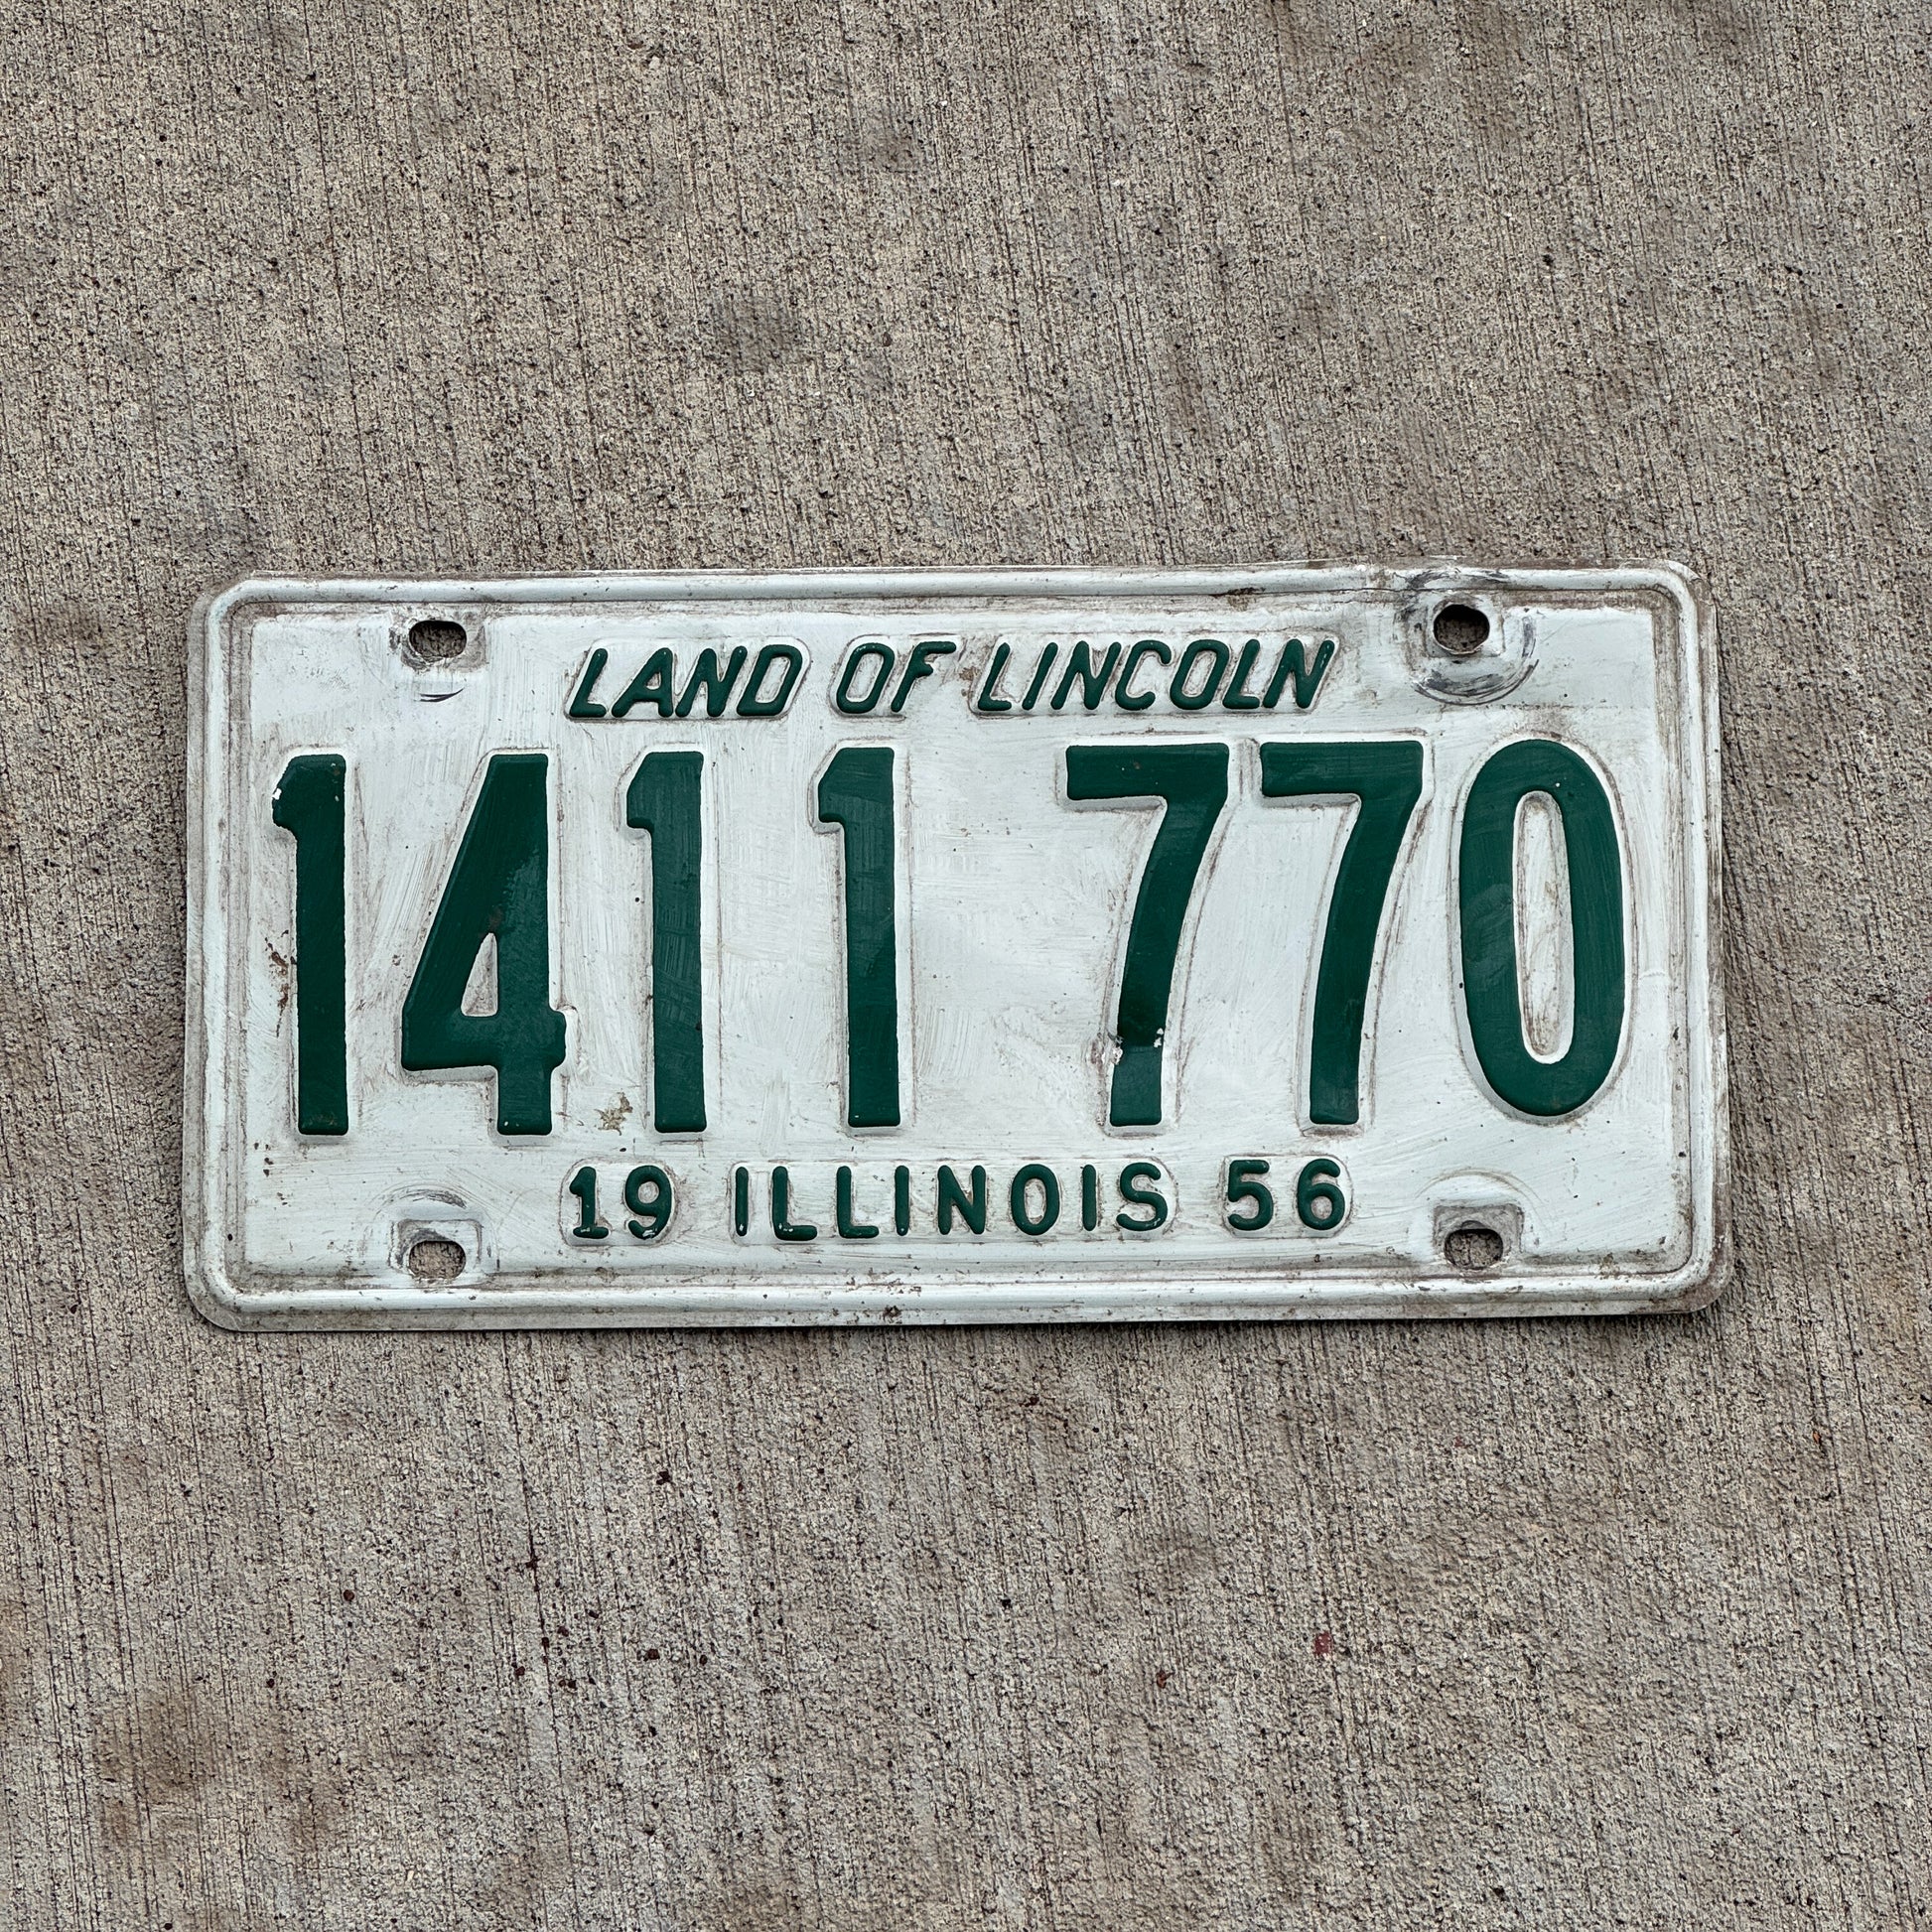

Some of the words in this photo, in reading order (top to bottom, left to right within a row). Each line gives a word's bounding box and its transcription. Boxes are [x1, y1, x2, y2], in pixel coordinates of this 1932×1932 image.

[570, 645, 803, 718] LAND
[836, 641, 957, 713] OF
[977, 638, 1335, 711] LINCOLN
[272, 747, 901, 1135] 1411
[1064, 738, 1626, 1126] 770
[569, 1165, 674, 1239] 19
[735, 1163, 1170, 1240] ILLINOIS
[1226, 1158, 1346, 1231] 56
